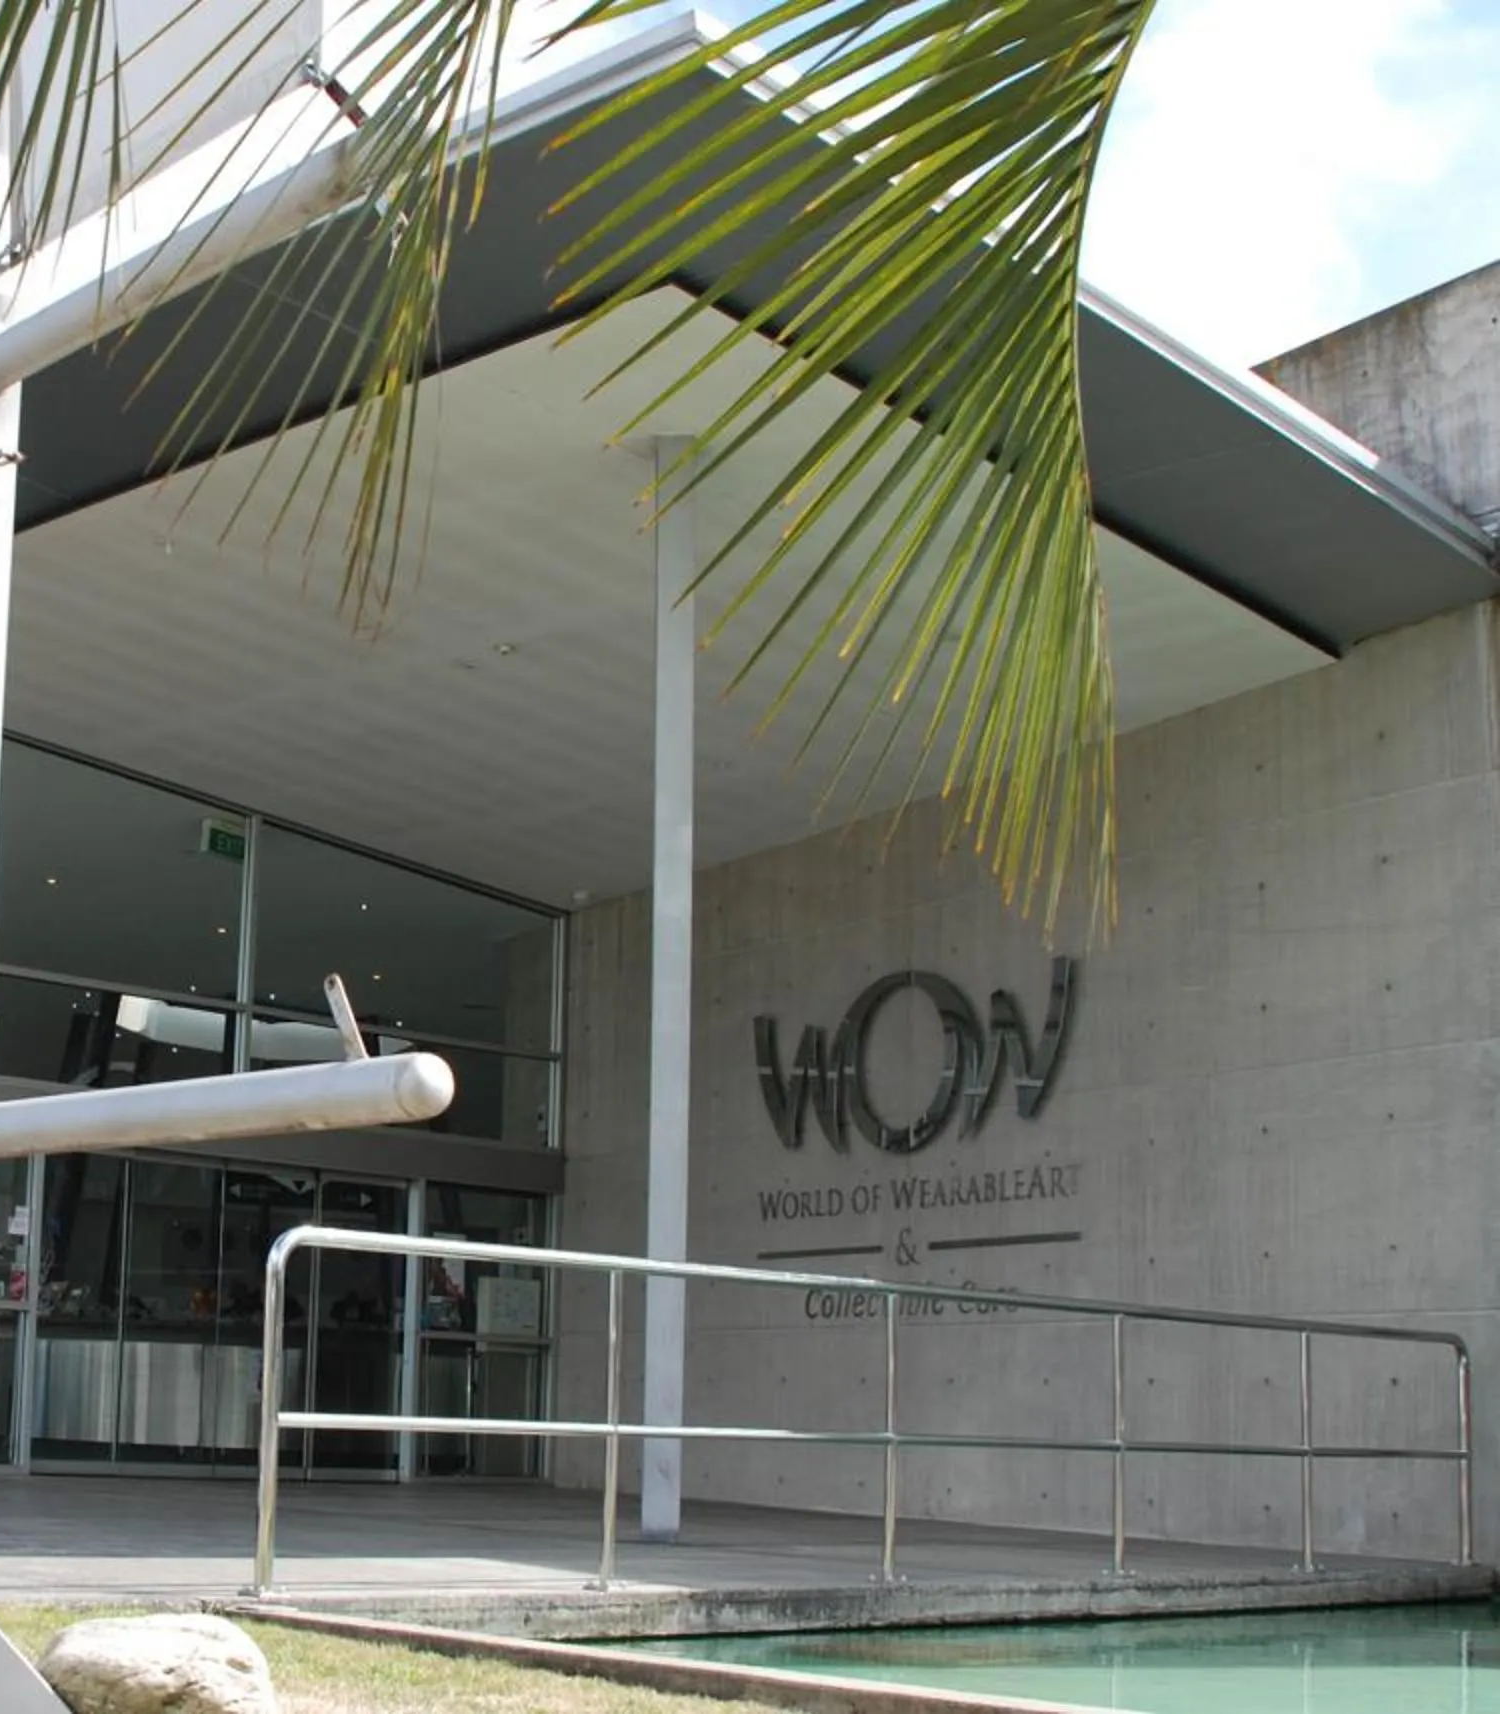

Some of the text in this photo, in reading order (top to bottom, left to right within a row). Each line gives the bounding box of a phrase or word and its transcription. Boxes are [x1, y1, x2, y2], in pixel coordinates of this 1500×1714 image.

[753, 954, 1081, 1155] WOW
[759, 1187, 844, 1221] WORLD
[850, 1183, 883, 1215] OF
[895, 1227, 920, 1267] &
